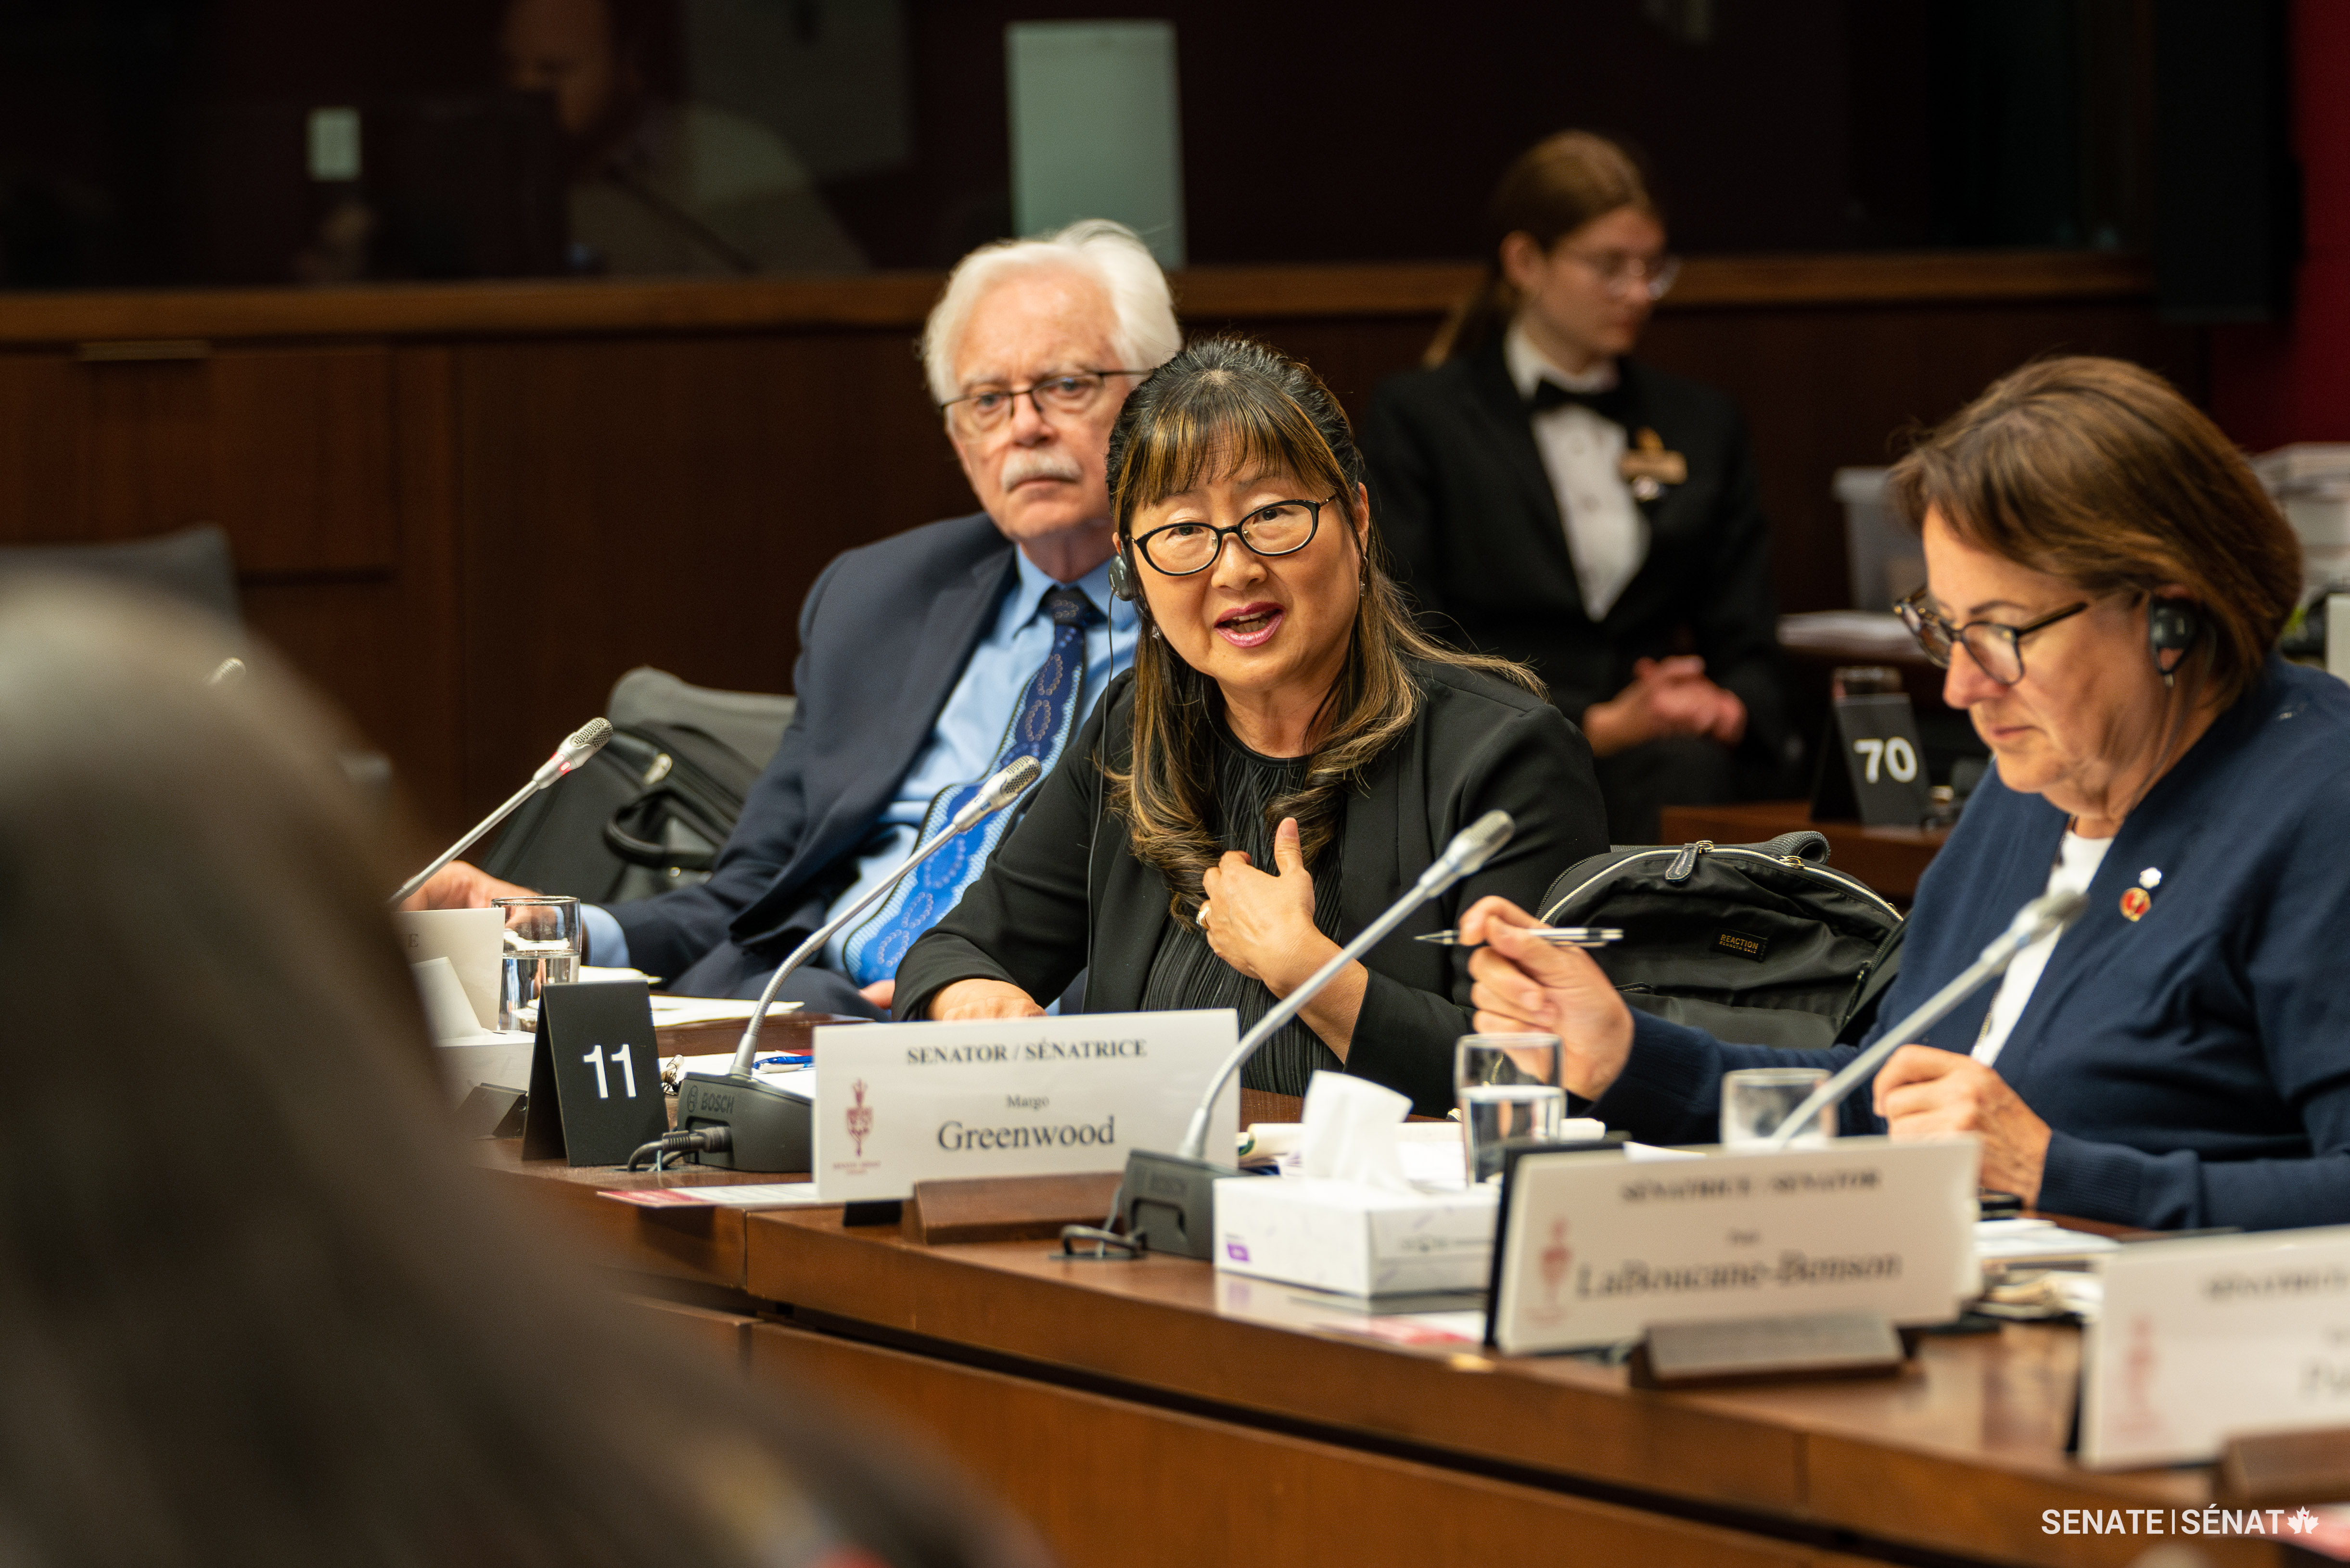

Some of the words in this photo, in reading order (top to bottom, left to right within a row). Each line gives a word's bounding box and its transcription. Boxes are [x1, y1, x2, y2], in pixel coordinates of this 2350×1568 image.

[1853, 736, 1917, 784] 70
[1720, 934, 1759, 950] REACTION
[907, 1043, 1008, 1064] SENATOR
[1025, 1037, 1147, 1059] SÉNATRICE
[583, 1044, 637, 1098] 11
[701, 1092, 735, 1114] BOSCH
[1007, 1095, 1049, 1111] Margo
[938, 1114, 1115, 1151] Greenwood
